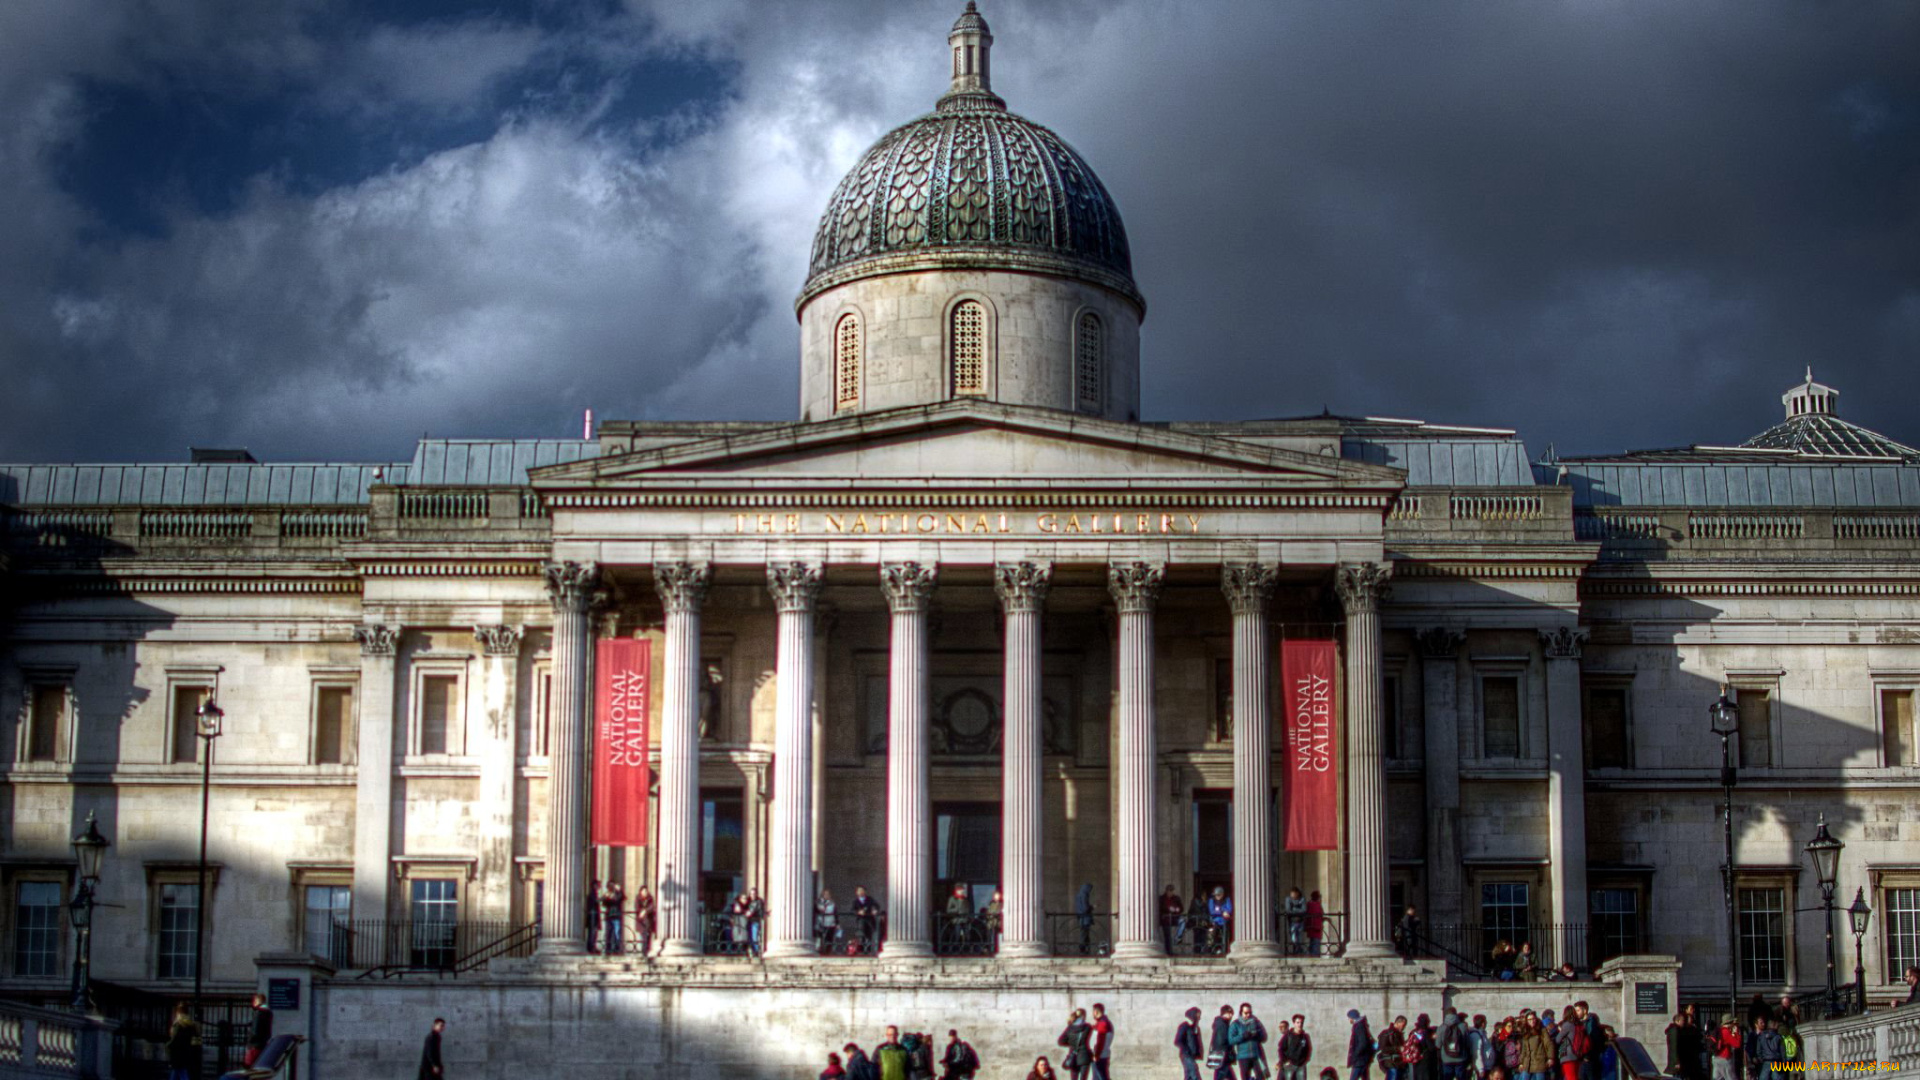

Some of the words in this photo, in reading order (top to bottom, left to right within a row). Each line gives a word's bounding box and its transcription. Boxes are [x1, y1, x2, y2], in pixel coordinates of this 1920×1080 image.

[731, 513, 800, 533] THE
[825, 513, 1012, 533] NATIONAL
[1037, 513, 1203, 533] GALLERY
[601, 722, 610, 739] THE
[610, 669, 626, 765] NATIONAL
[625, 670, 644, 767] GALLERY
[1297, 674, 1311, 771] NATIONAL
[1313, 674, 1329, 772] GALLERY
